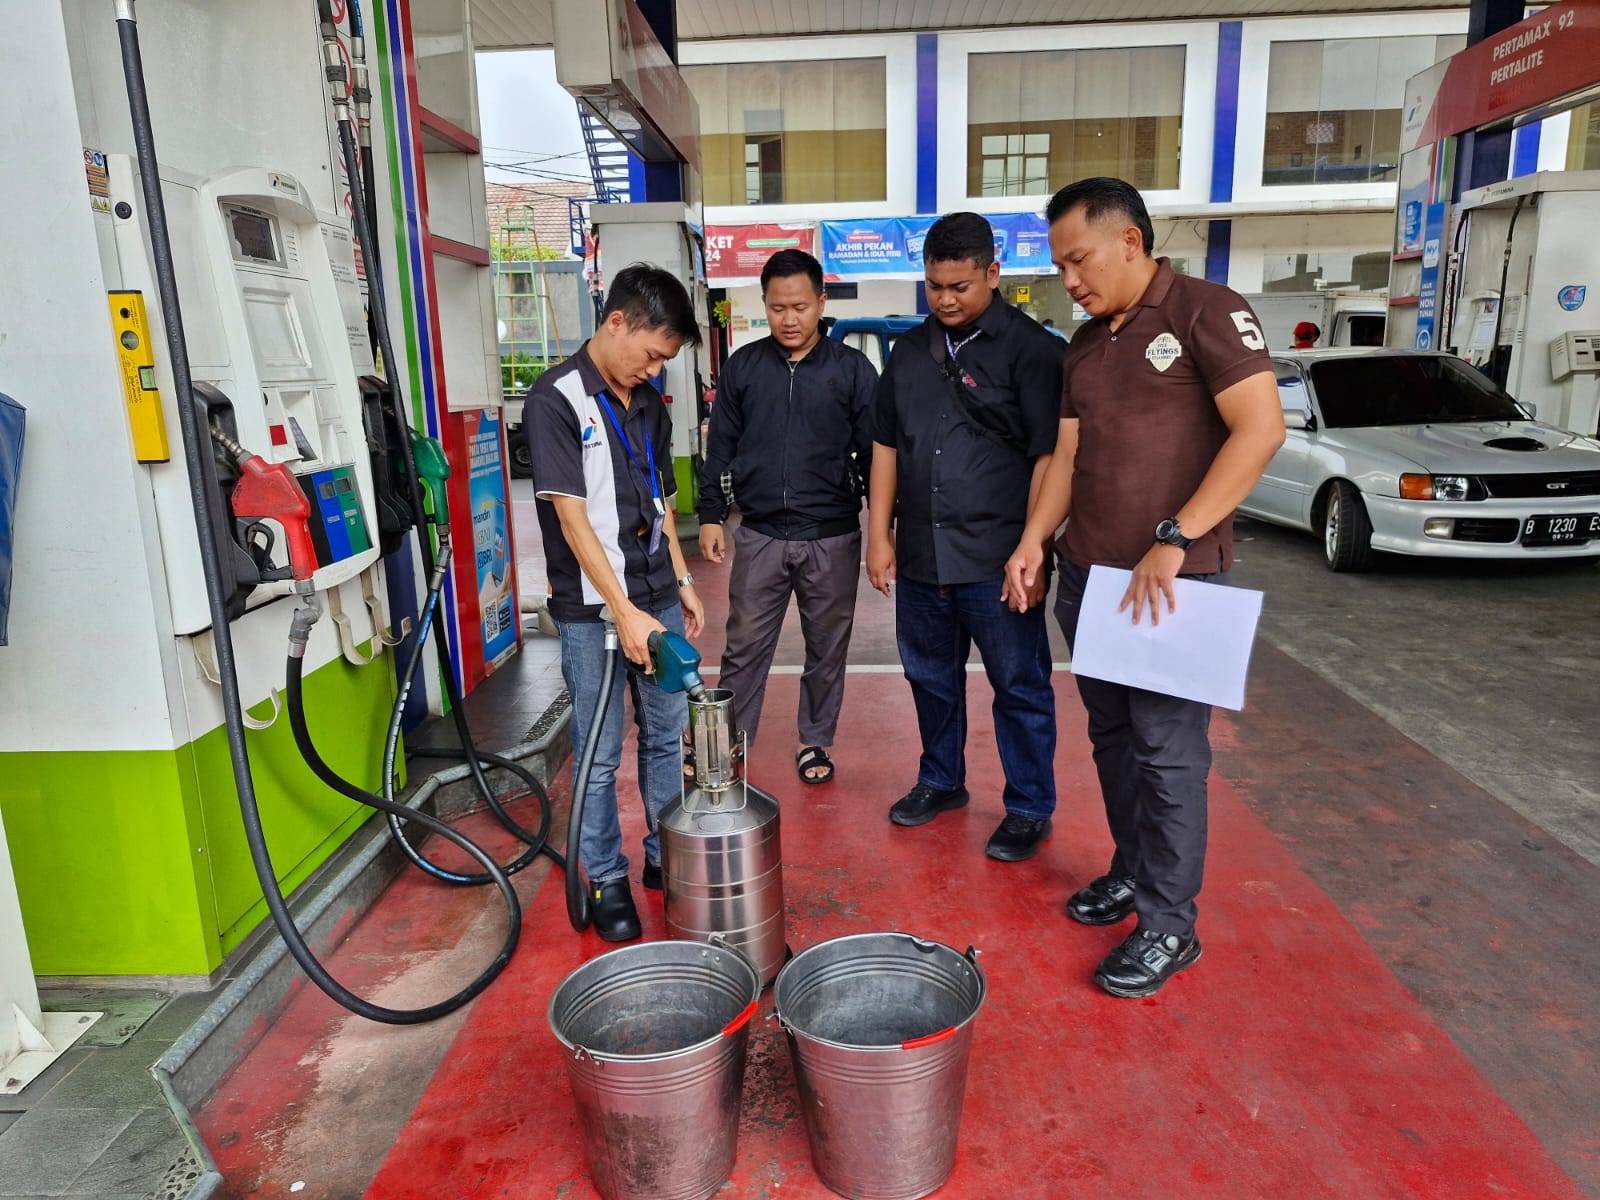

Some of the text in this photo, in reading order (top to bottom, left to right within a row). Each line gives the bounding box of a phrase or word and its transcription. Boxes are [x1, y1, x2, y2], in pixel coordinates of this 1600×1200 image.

[1492, 9, 1574, 62] PERTAMAX 92
[1490, 49, 1544, 87] PERTALITE
[836, 241, 894, 251] AKHIR PEKAN
[828, 251, 863, 259] RAMADAN
[864, 250, 869, 258] &
[870, 250, 885, 258] IDUL
[1420, 299, 1434, 308] NON
[1229, 310, 1265, 351] 5
[1147, 347, 1179, 356] FLYINGS
[1546, 482, 1569, 490] GT
[1525, 519, 1535, 535] B
[1548, 518, 1577, 533] 1230
